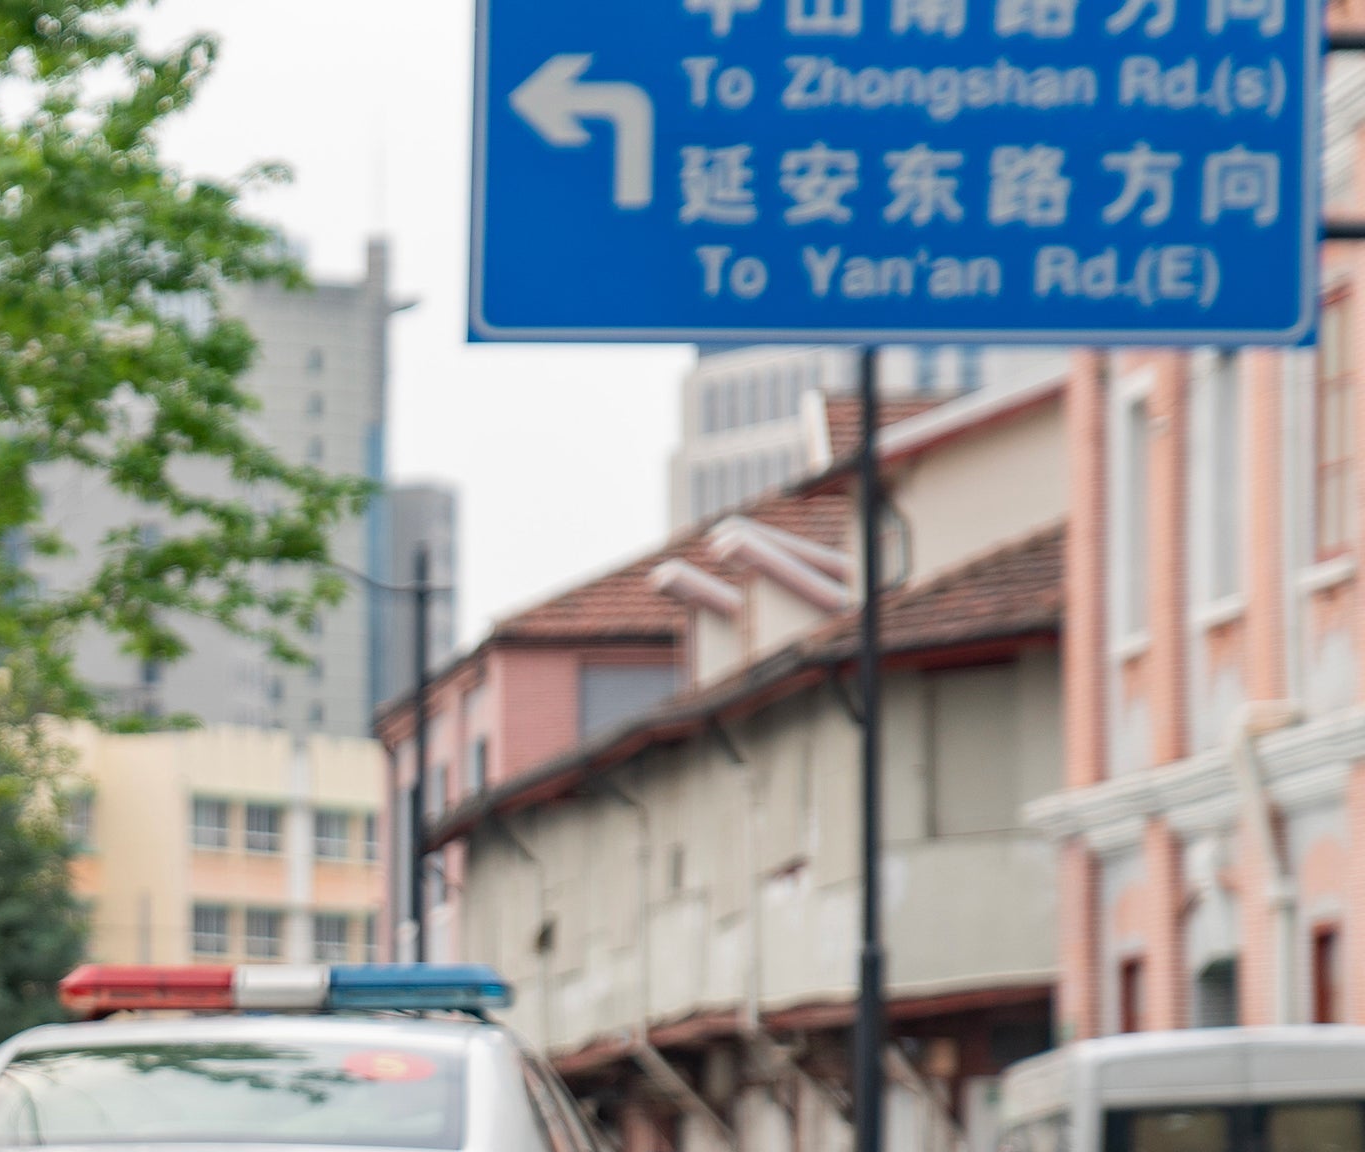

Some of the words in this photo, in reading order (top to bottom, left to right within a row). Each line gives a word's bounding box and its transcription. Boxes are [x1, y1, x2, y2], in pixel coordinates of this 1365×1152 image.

[682, 57, 754, 108] To
[782, 56, 1096, 119] Zhongshan
[679, 143, 1280, 226] 延安东路方向
[697, 246, 767, 297] To
[804, 247, 1000, 298] Yan'an
[1035, 246, 1220, 305] Rd.(E)
